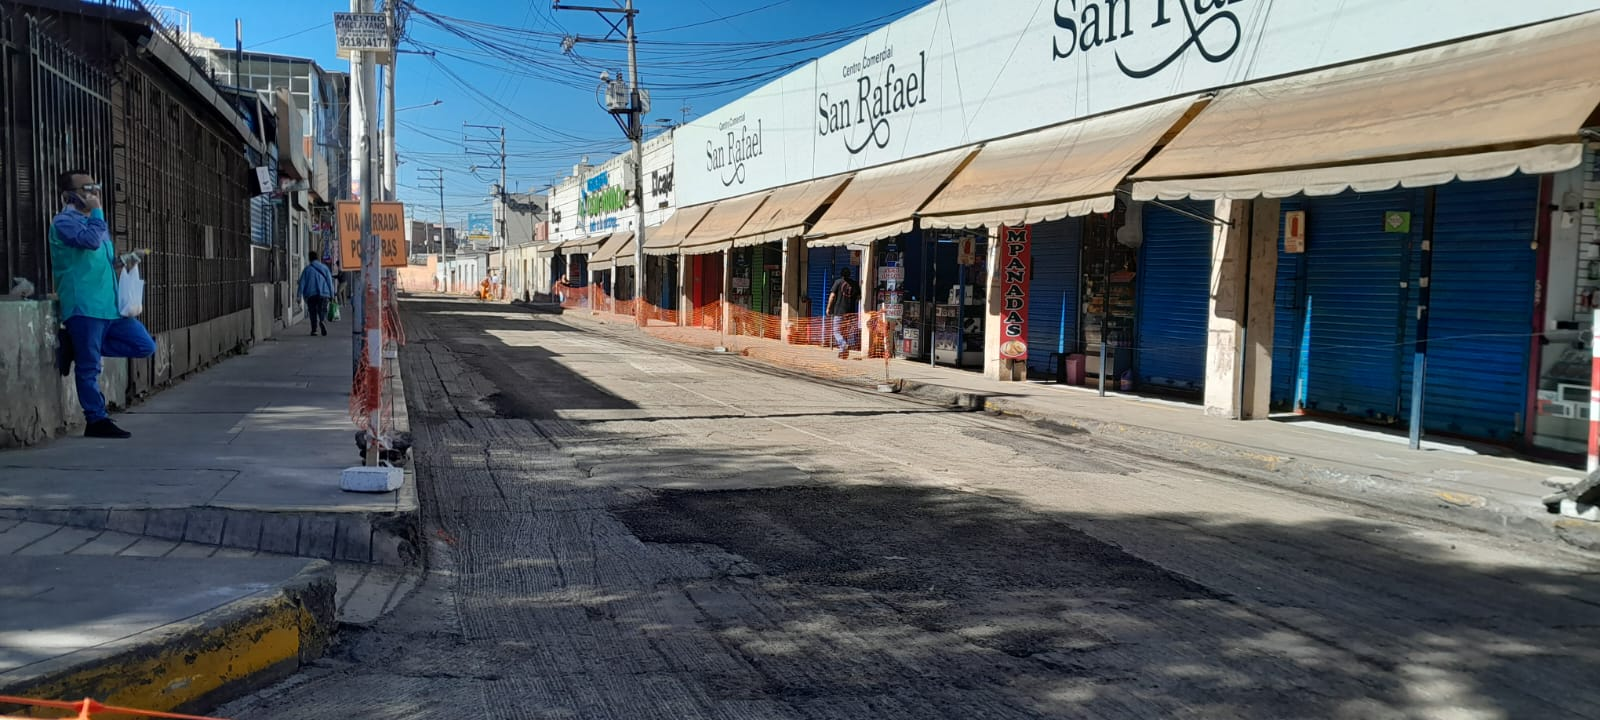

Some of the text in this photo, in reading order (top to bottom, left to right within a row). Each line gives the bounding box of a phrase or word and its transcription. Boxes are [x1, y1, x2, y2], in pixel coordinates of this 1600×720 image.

[336, 14, 385, 22] MAESTRO
[336, 20, 386, 30] CHICLAYANO
[1052, 0, 1134, 61] San
[842, 44, 893, 78] Centro Comercial
[819, 50, 926, 154] San Rafael
[706, 118, 762, 187] San Rafael
[344, 212, 399, 232] VIA RRADA
[351, 239, 361, 258] PO
[381, 238, 397, 257] RAS
